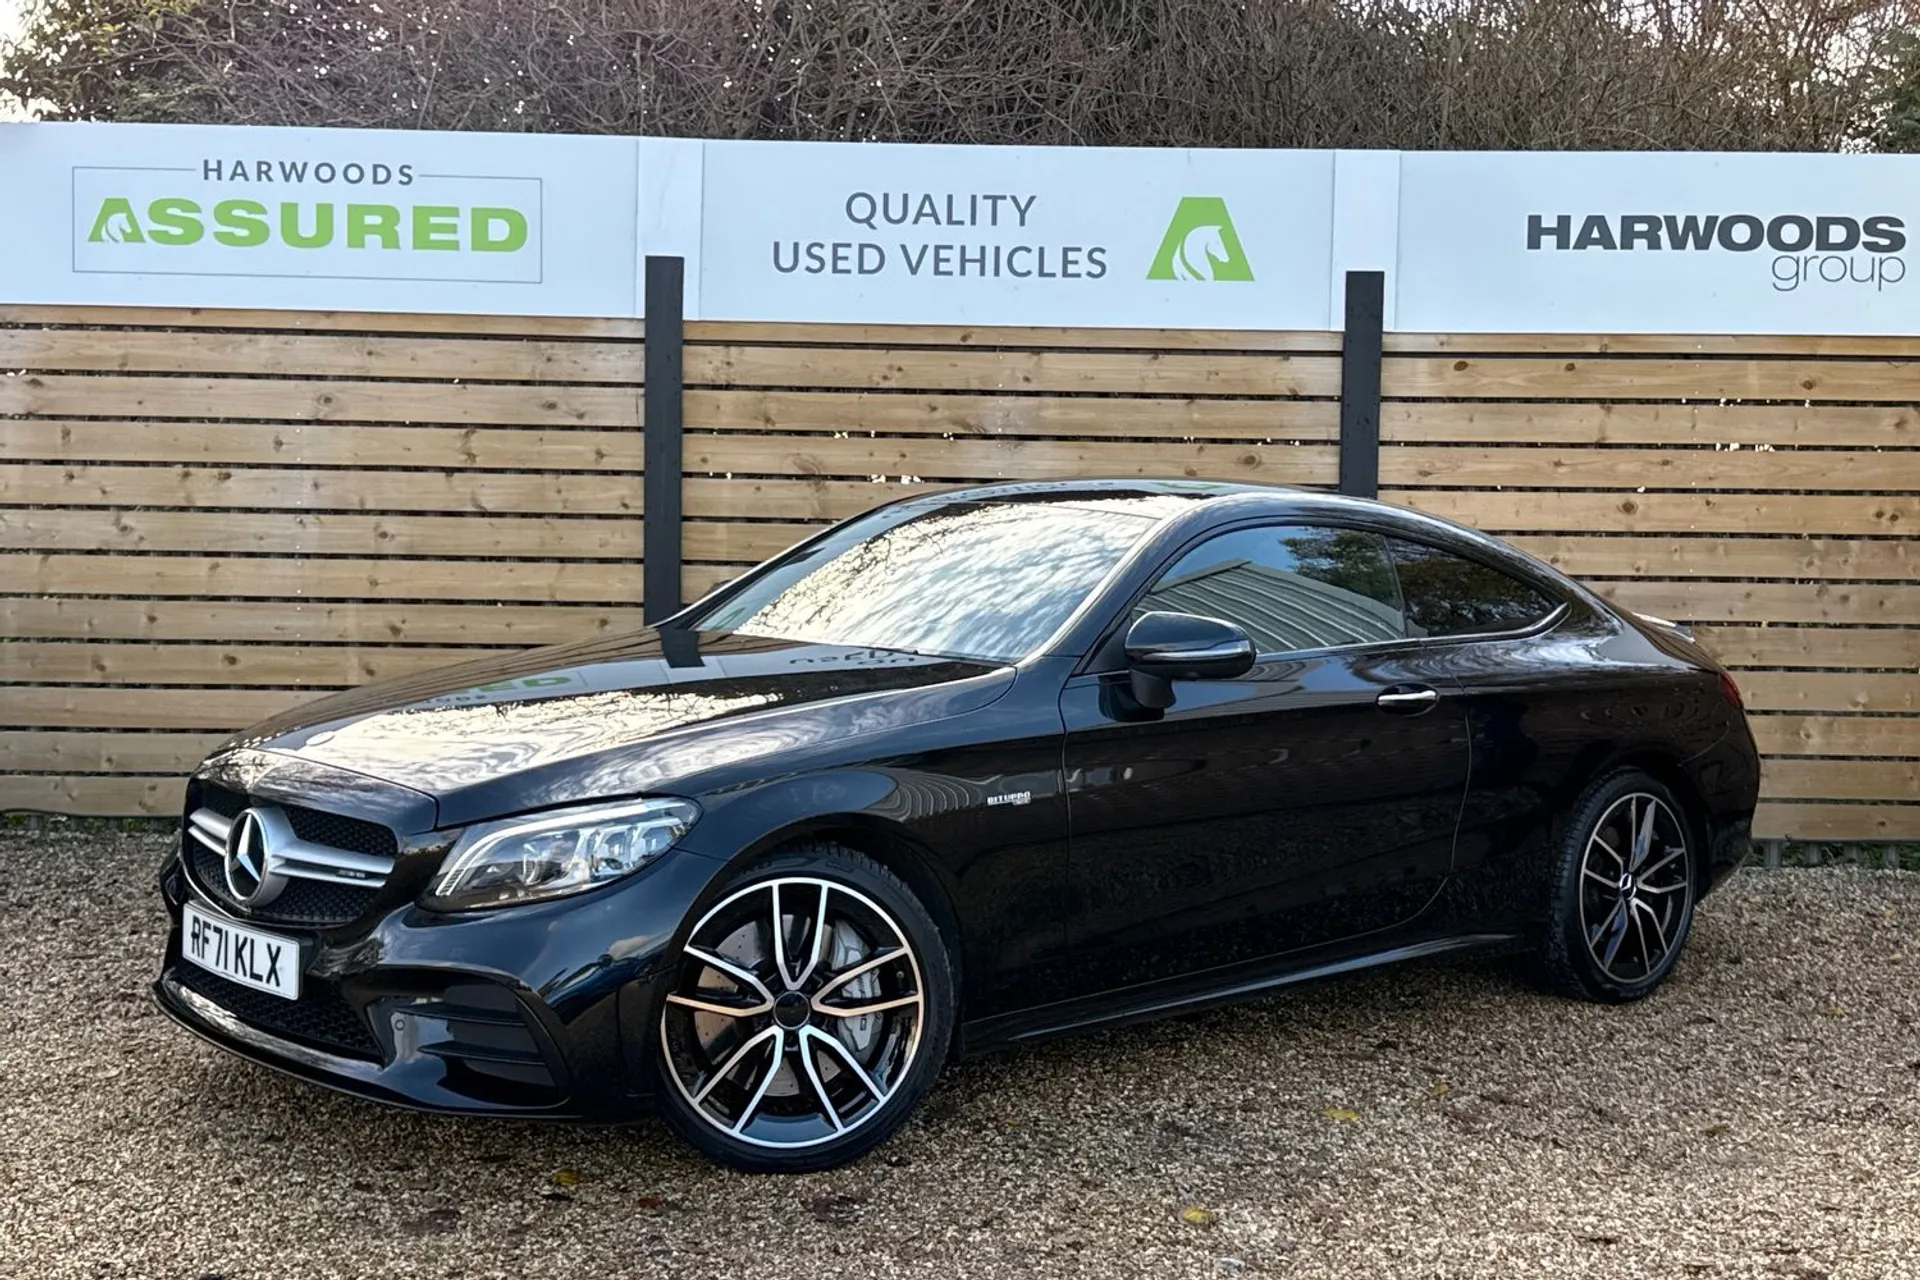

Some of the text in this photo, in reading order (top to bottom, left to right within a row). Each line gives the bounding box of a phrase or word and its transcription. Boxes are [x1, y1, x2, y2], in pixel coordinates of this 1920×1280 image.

[202, 158, 415, 187] HARWOODS
[88, 197, 529, 253] ASSURED
[844, 191, 1037, 229] QUALITY
[1526, 213, 1907, 253] HARWOODS
[772, 241, 1108, 280] USED VEHICLES
[1771, 254, 1906, 292] group
